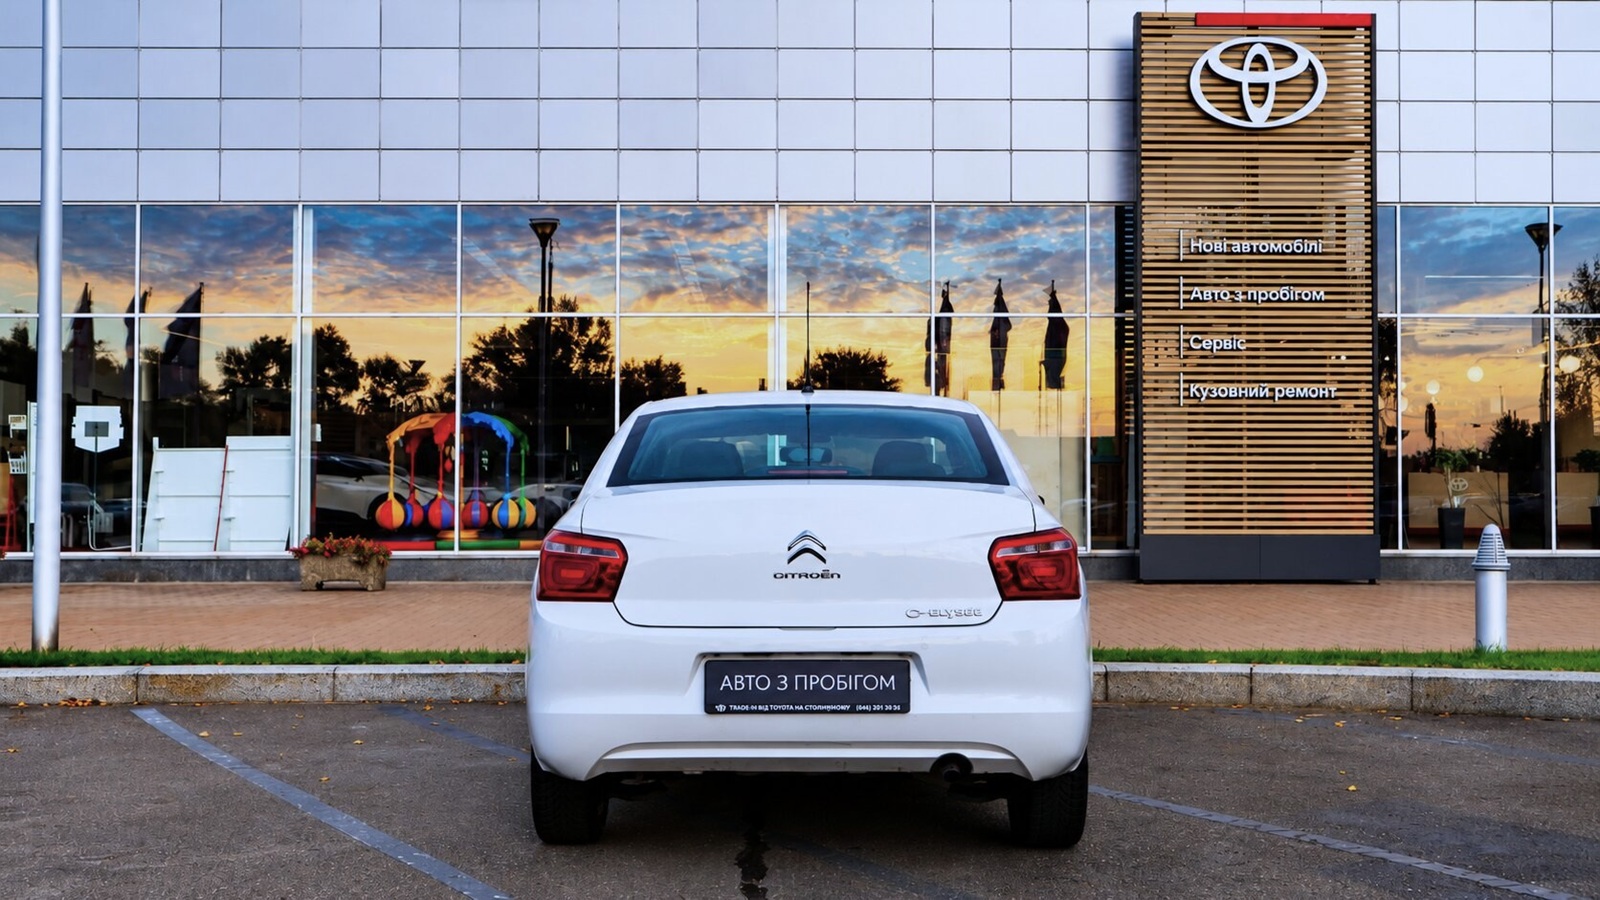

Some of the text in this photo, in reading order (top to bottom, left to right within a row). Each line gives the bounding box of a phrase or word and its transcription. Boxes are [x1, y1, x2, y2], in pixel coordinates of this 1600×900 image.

[1190, 238, 1323, 253] Нові автомобілі
[1190, 286, 1325, 303] Авто з пробігом
[1189, 335, 1246, 353] Сервіс
[1189, 383, 1337, 402] Кузовний ремонт
[720, 674, 896, 691] АВТО З ПРОБІГОМ
